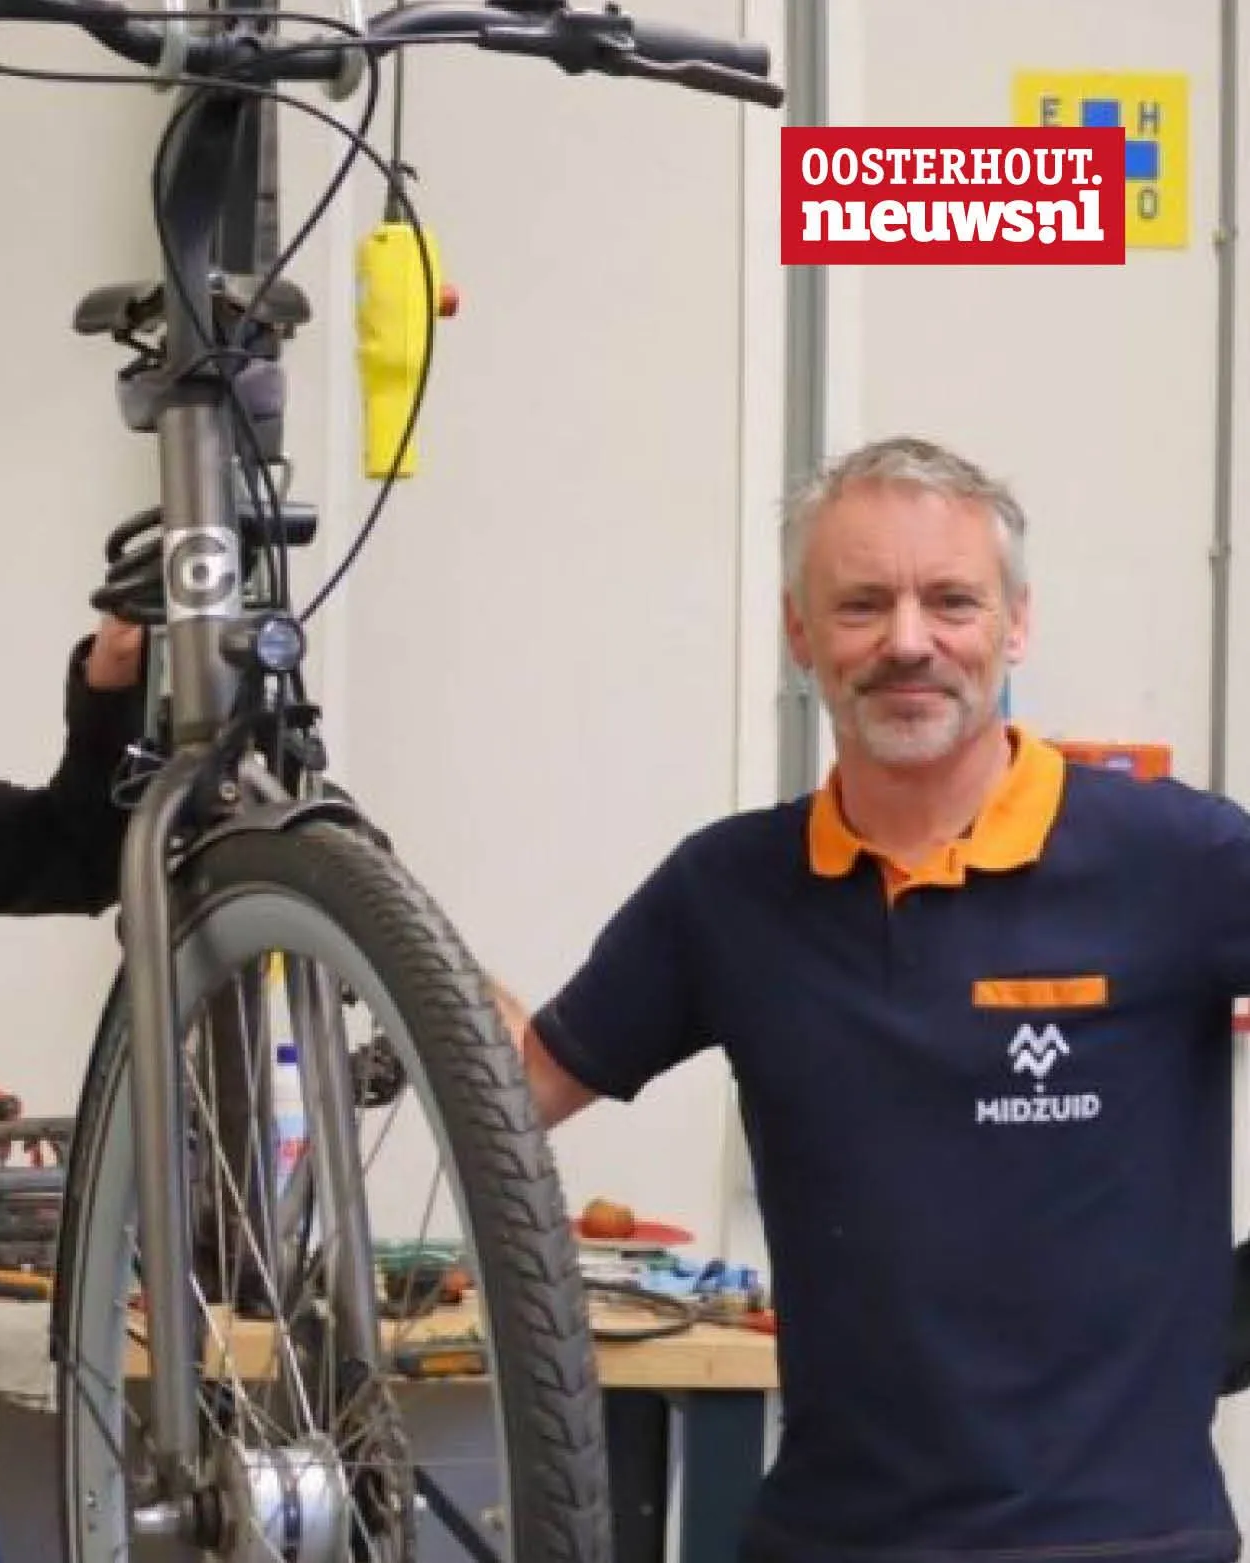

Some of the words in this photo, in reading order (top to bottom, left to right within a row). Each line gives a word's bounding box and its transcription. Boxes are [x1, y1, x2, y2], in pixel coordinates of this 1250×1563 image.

[1138, 101, 1160, 133] H
[1139, 187, 1159, 220] O
[976, 1094, 1100, 1122] MIDZUID
